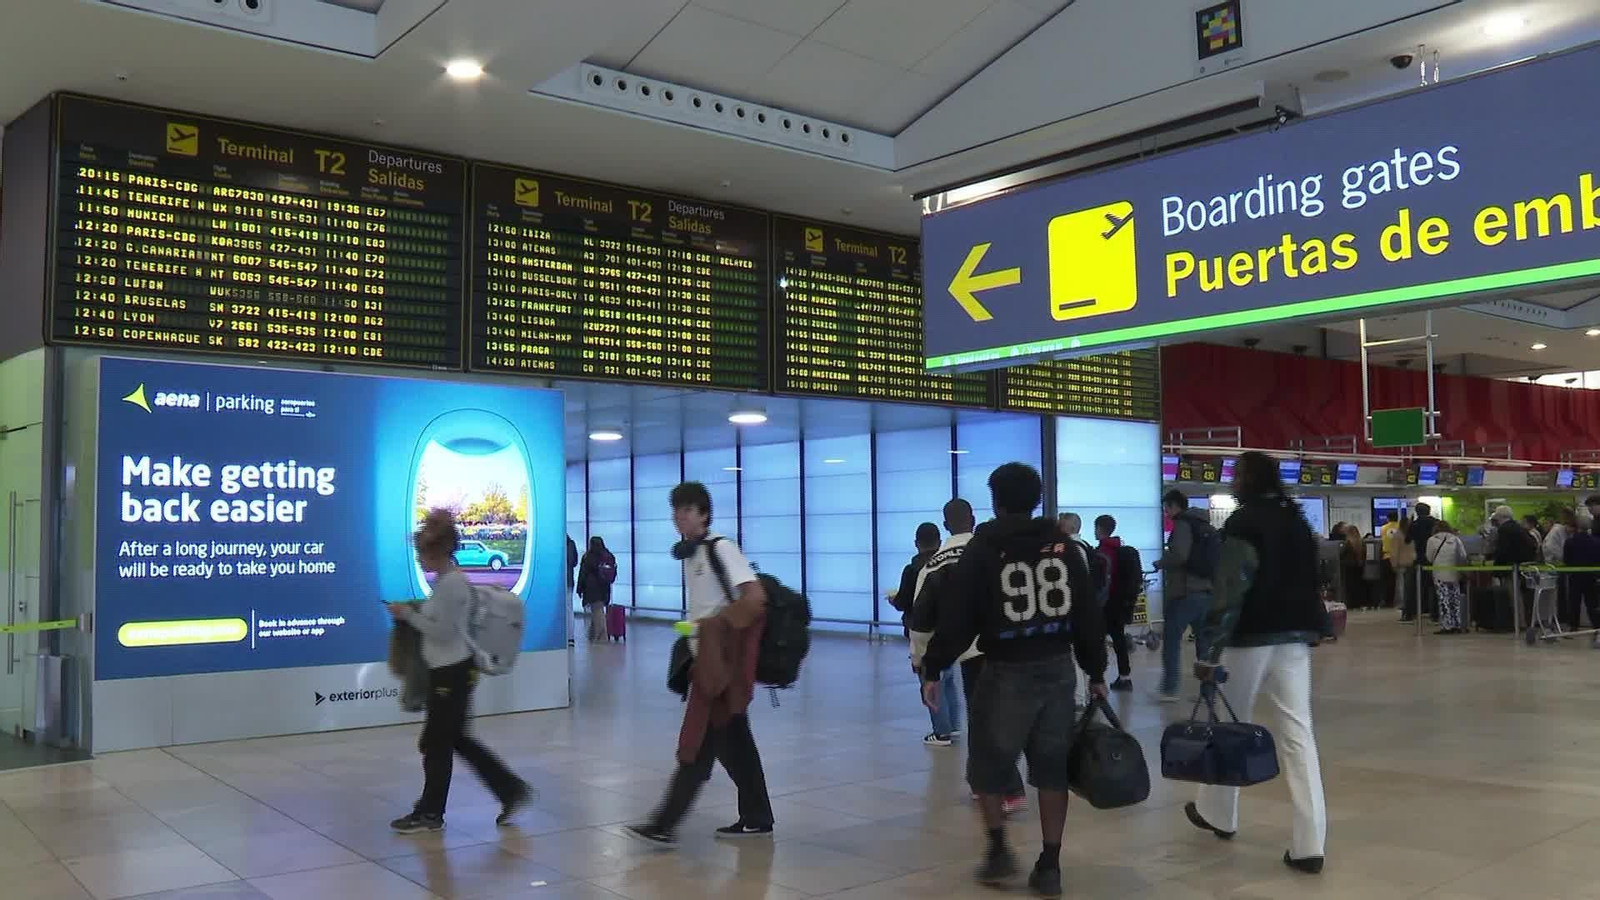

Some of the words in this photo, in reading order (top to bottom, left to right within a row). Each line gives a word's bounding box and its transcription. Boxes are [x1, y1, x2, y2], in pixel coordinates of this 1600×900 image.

[217, 137, 294, 164] Terminal
[314, 150, 346, 175] T2
[368, 150, 442, 174] Departures
[79, 168, 119, 183] 20:15
[128, 174, 197, 193] PARIS-CDG
[270, 193, 319, 208] 427-431
[368, 168, 425, 191] Salidas
[1162, 172, 1325, 237] Boarding
[1341, 144, 1461, 210] gates
[78, 185, 118, 200] 11:45
[127, 191, 189, 209] TENERIFE
[197, 200, 204, 210] N
[212, 202, 226, 213] UX
[555, 191, 613, 214] Terminal
[628, 200, 652, 222] T2
[668, 200, 725, 220] Departures
[78, 203, 118, 217] 11:50
[126, 209, 173, 224] MUNICH
[212, 219, 226, 230] LH
[269, 225, 318, 240] 415-419
[668, 216, 712, 234] Salidas
[77, 220, 117, 234] 12:20
[126, 226, 196, 243] PARIS-CDG
[269, 242, 318, 256] 427-431
[325, 248, 358, 260] 11:40
[1165, 232, 1359, 298] Puertas
[1379, 208, 1450, 262] de
[1473, 172, 1600, 247] emb
[76, 238, 117, 252] 12:20
[125, 243, 195, 259] G.CANARIA
[211, 252, 225, 262] NT
[233, 254, 261, 266] 6007
[268, 258, 318, 272] 545-547
[325, 264, 358, 276] 11:40
[365, 268, 384, 279] E72
[835, 238, 878, 258] Terminal
[888, 246, 907, 264] T2
[76, 255, 116, 269] 12:20
[125, 260, 187, 275] TENERIFE
[210, 268, 225, 279] NT
[268, 274, 317, 288] 545-547
[324, 279, 357, 292] 11:40
[522, 257, 571, 272] AMSTERDAM
[124, 277, 163, 290] LUTON
[75, 290, 115, 303] 12:40
[124, 294, 186, 309] BRUSELAS
[209, 301, 224, 312] SN
[231, 303, 260, 315] 3722
[267, 306, 316, 320] 415-419
[323, 311, 356, 323] 12:00
[521, 301, 571, 314] FRANKFURT
[74, 308, 115, 320] 12:40
[123, 311, 155, 323] LYON
[231, 320, 259, 331] 2661
[267, 323, 316, 335] 535-535
[521, 315, 555, 327] LISBOA
[74, 325, 114, 338] 12:50
[123, 329, 200, 344] COPENHAGUE
[208, 335, 223, 345] SK
[266, 339, 315, 351] 422-423
[521, 360, 554, 371] ATENAS
[154, 392, 200, 408] aena
[216, 394, 274, 414] parking
[122, 455, 212, 486] Make
[220, 460, 336, 495] getting
[121, 490, 200, 522] back
[210, 493, 308, 522] easier
[119, 541, 159, 557] After
[162, 544, 172, 556] a
[176, 541, 208, 558] long
[210, 541, 267, 559] journey,
[270, 542, 302, 558] your
[304, 542, 324, 555] car
[118, 562, 146, 578] will
[150, 562, 168, 577] be
[173, 562, 214, 579] ready
[218, 562, 232, 576] to
[237, 560, 266, 576] take
[270, 562, 295, 578] you
[298, 560, 336, 574] home
[1000, 557, 1072, 622] 98
[258, 619, 278, 628] Book
[278, 618, 286, 628] in
[287, 618, 316, 627] advance
[317, 616, 345, 627] through
[258, 630, 272, 638] our
[272, 628, 301, 637] website
[302, 628, 310, 636] or
[311, 628, 324, 637] app
[329, 687, 398, 702] exteriorplus
